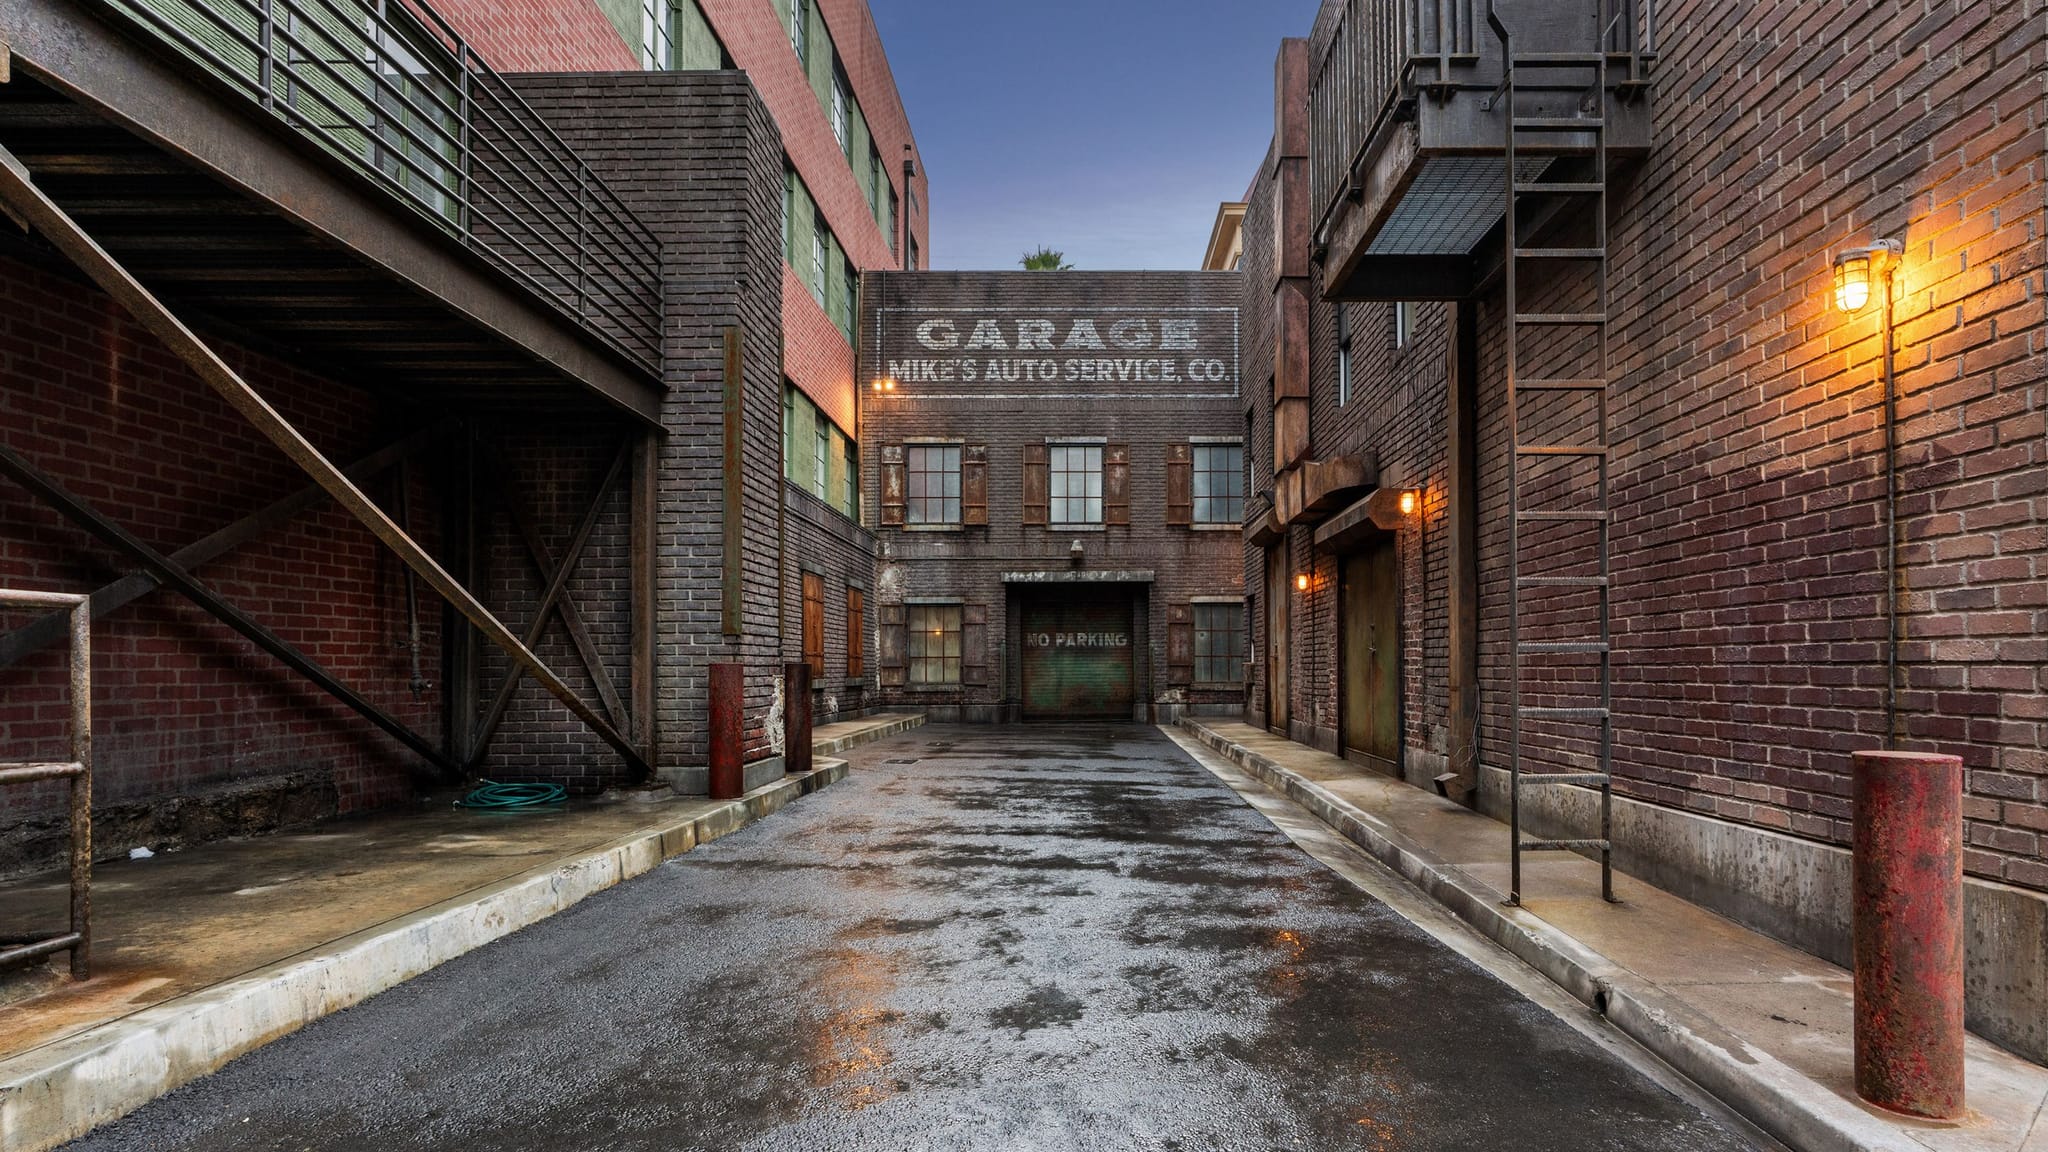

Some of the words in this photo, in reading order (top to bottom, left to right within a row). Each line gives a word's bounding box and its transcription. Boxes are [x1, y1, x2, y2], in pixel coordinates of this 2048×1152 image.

[915, 318, 1199, 351] GARAGE
[888, 359, 977, 383] MIKE'S
[984, 359, 1059, 382] AUTO
[1188, 359, 1231, 382] CO.
[1027, 633, 1050, 647] NO
[1055, 633, 1128, 647] PARKING
